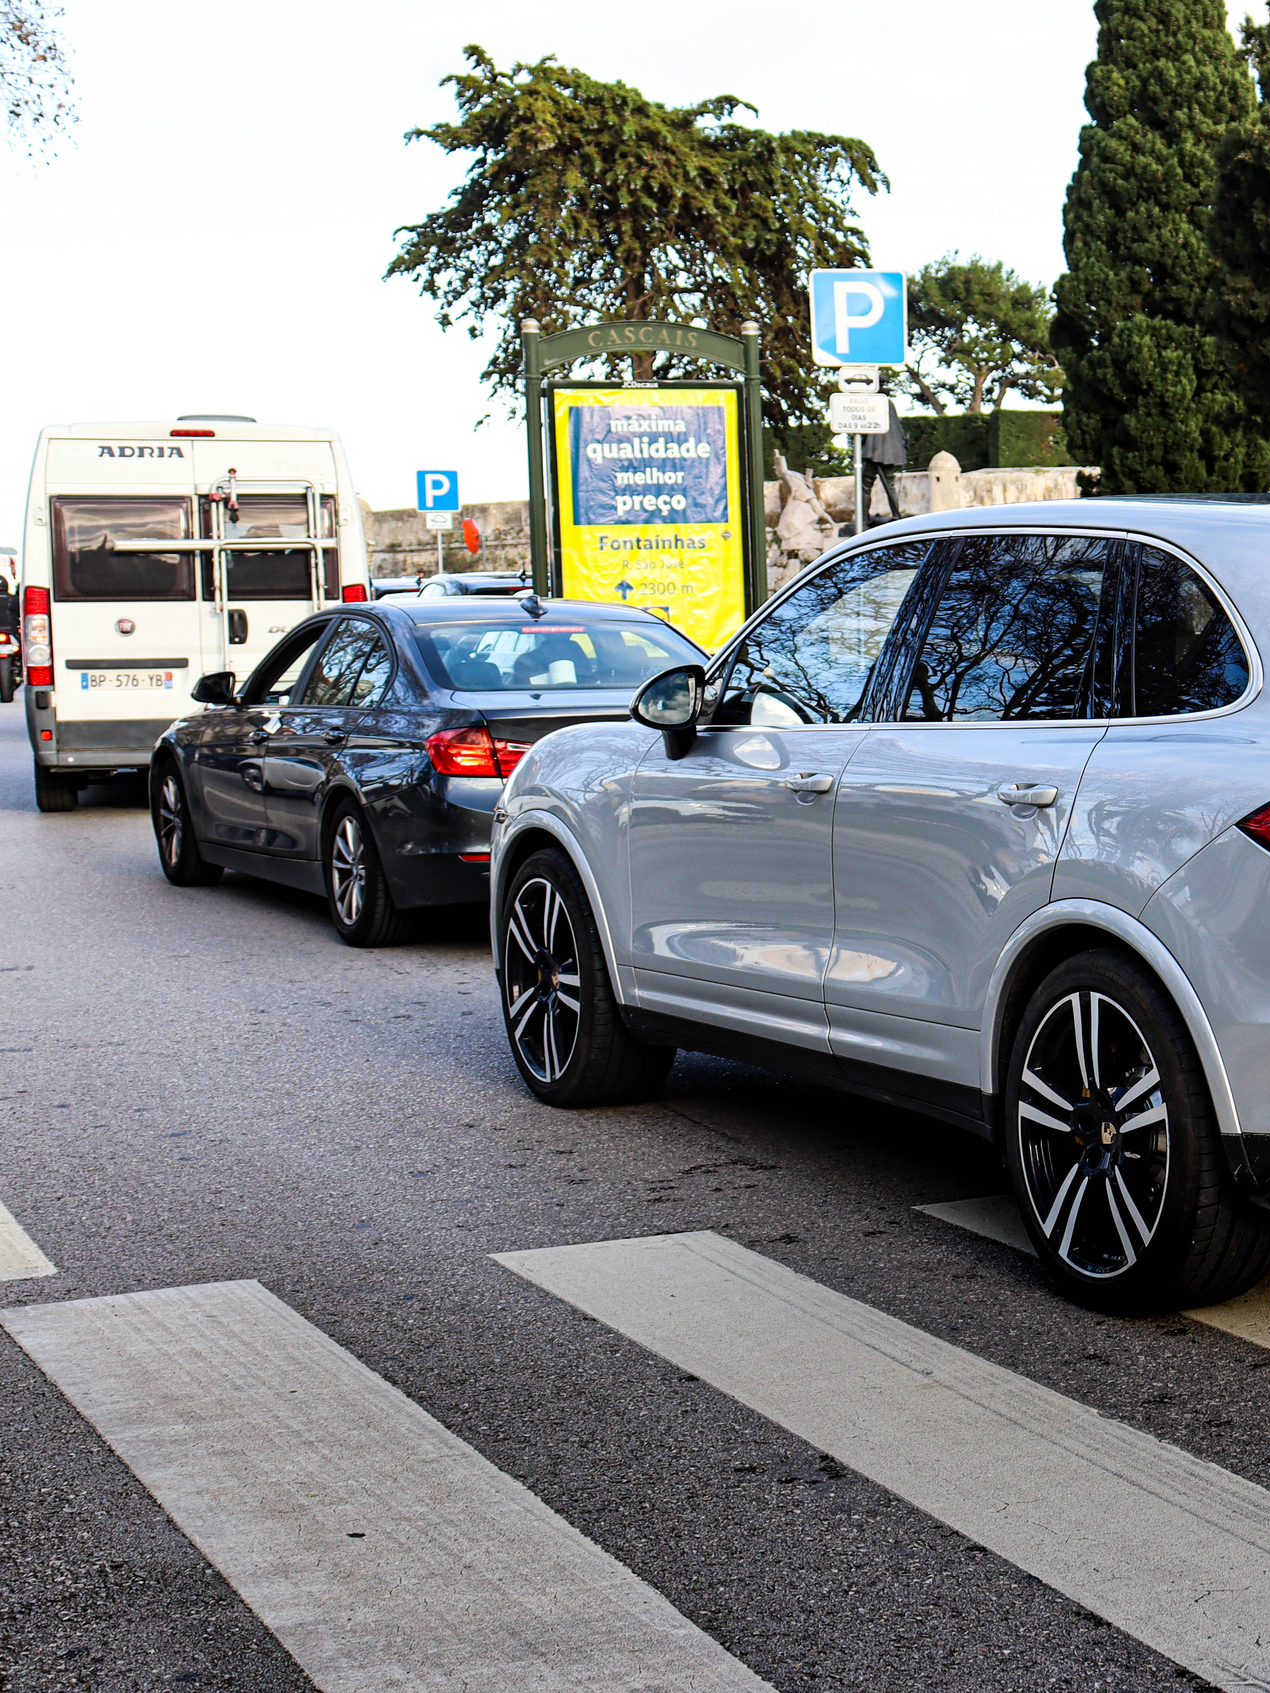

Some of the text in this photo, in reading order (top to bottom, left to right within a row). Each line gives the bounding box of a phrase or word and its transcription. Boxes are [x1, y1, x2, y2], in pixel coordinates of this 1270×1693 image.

[833, 281, 885, 354] P
[587, 326, 699, 347] CASCAIS
[621, 381, 659, 389] JCDecaux
[609, 415, 687, 432] máxima
[98, 446, 185, 458] ADRIA
[586, 436, 711, 464] qualidade
[615, 467, 685, 485] melhor
[425, 473, 451, 508] P
[615, 494, 687, 516] preço
[622, 557, 685, 570] R. São José
[640, 582, 694, 596] 2300 m
